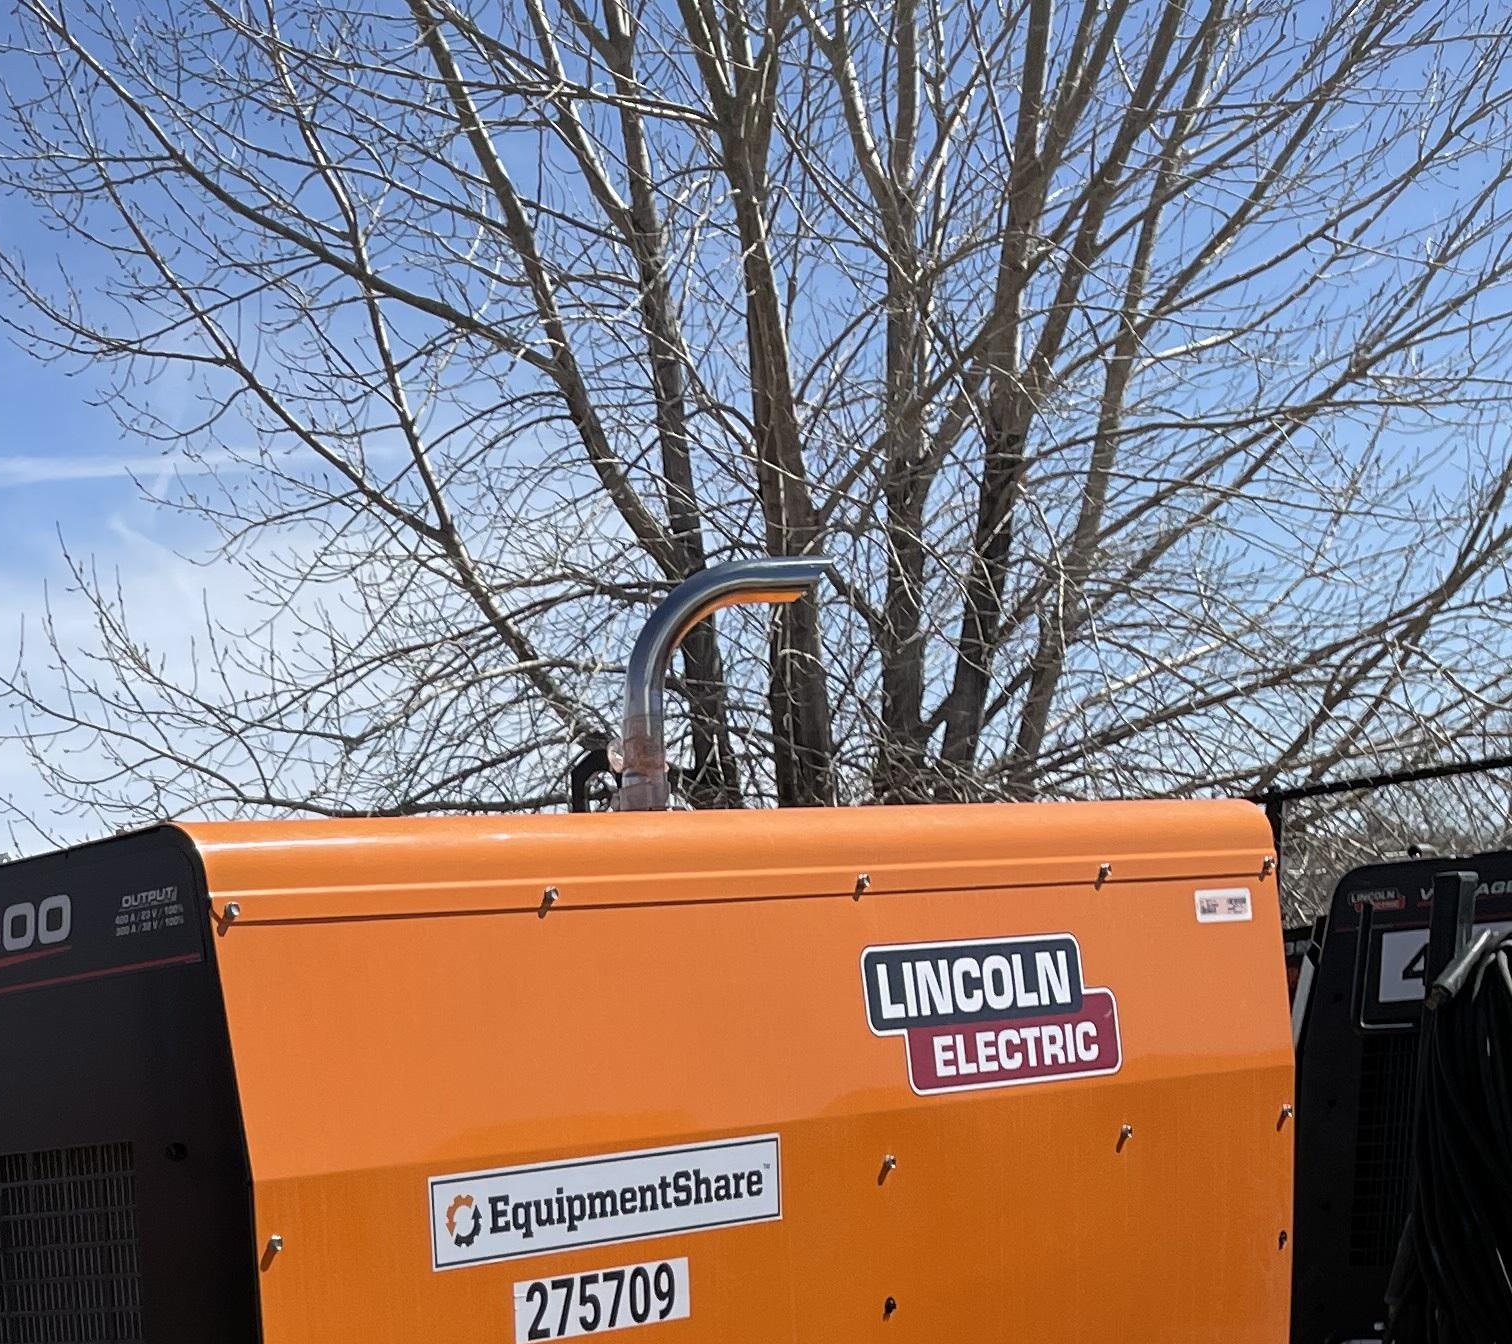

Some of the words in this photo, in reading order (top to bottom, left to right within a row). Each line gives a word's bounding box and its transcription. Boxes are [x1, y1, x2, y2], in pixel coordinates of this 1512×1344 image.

[121, 886, 174, 908] OUTPUT
[876, 950, 1072, 1020] LINCOLN
[932, 1021, 1100, 1078] ELECTRIC
[488, 1167, 764, 1239] EquipmentShare
[525, 1261, 676, 1342] 275709
